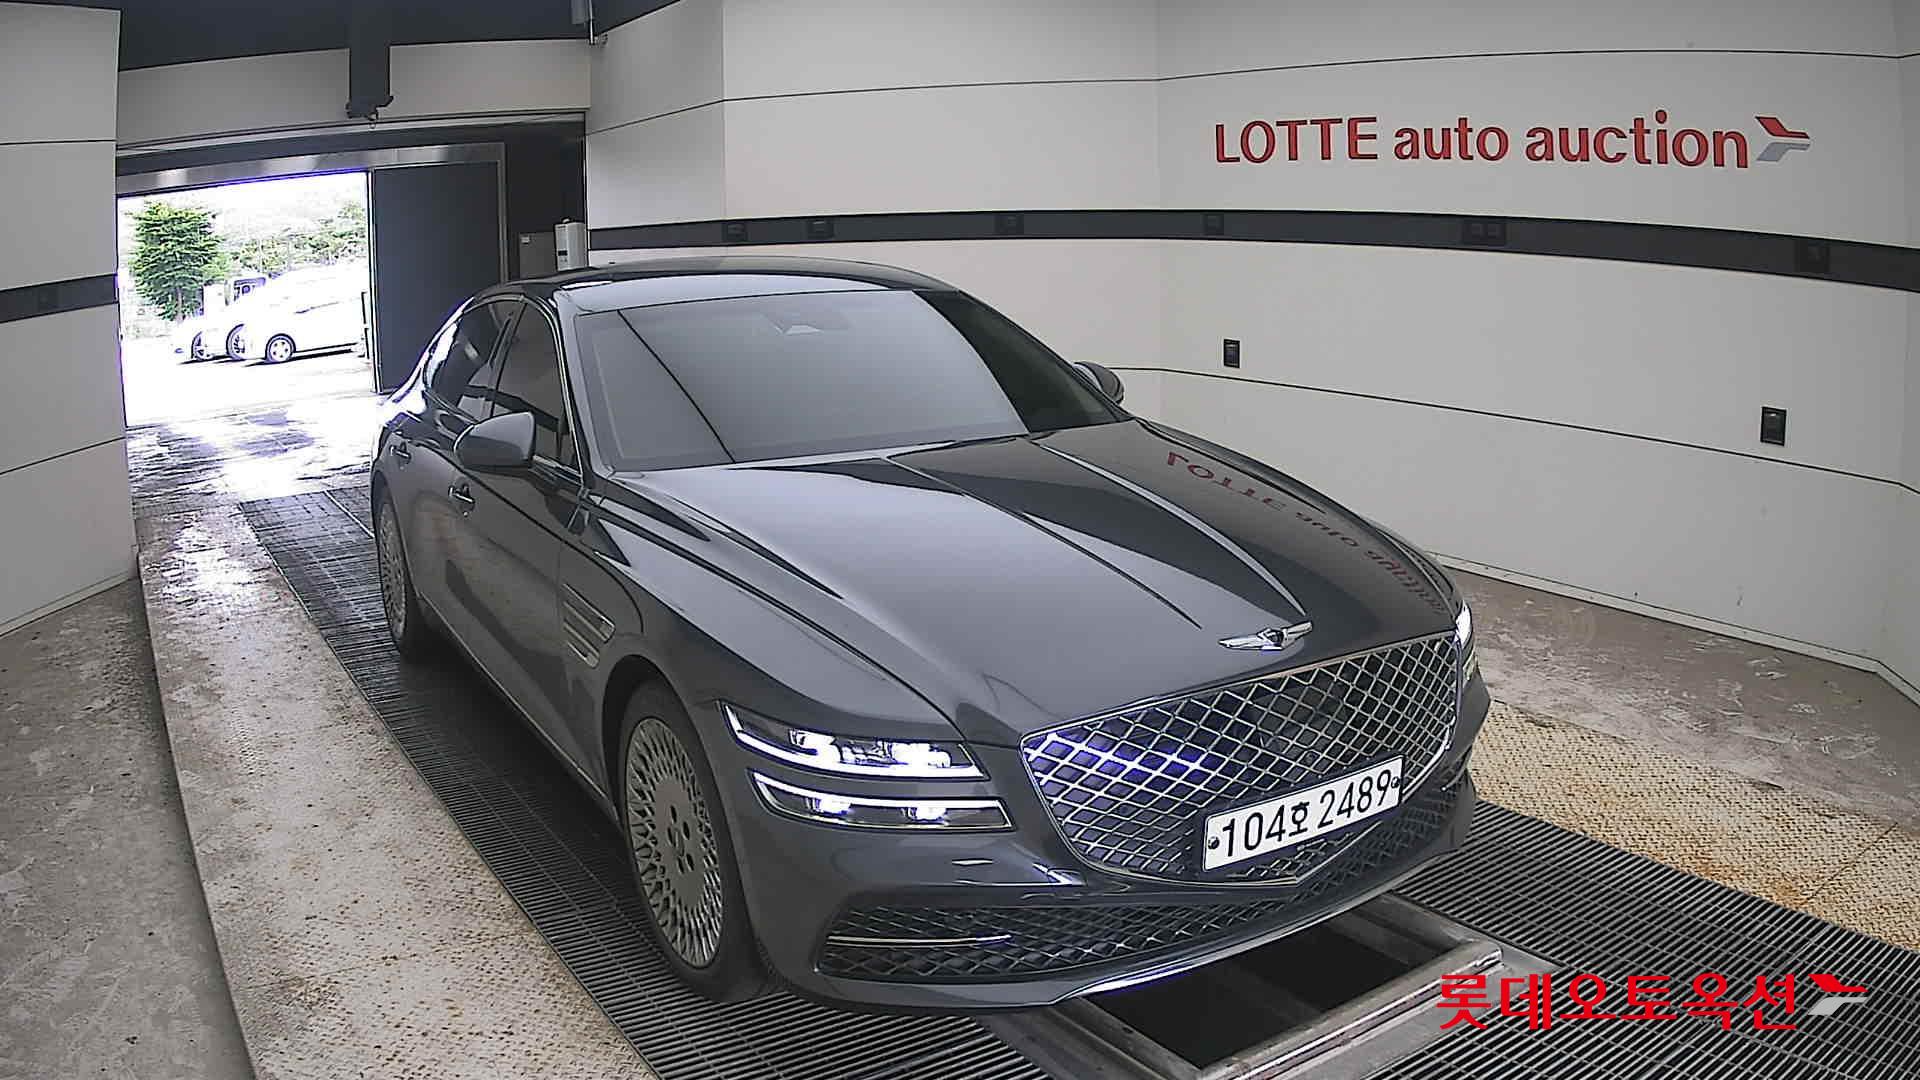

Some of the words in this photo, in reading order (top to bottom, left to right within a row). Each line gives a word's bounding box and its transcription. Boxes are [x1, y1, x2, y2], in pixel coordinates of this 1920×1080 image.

[1215, 116, 1378, 163] LOTTE
[1394, 117, 1509, 162] auto
[1525, 110, 1748, 168] auction
[1222, 802, 1310, 857] 104호
[1317, 769, 1392, 829] 2489
